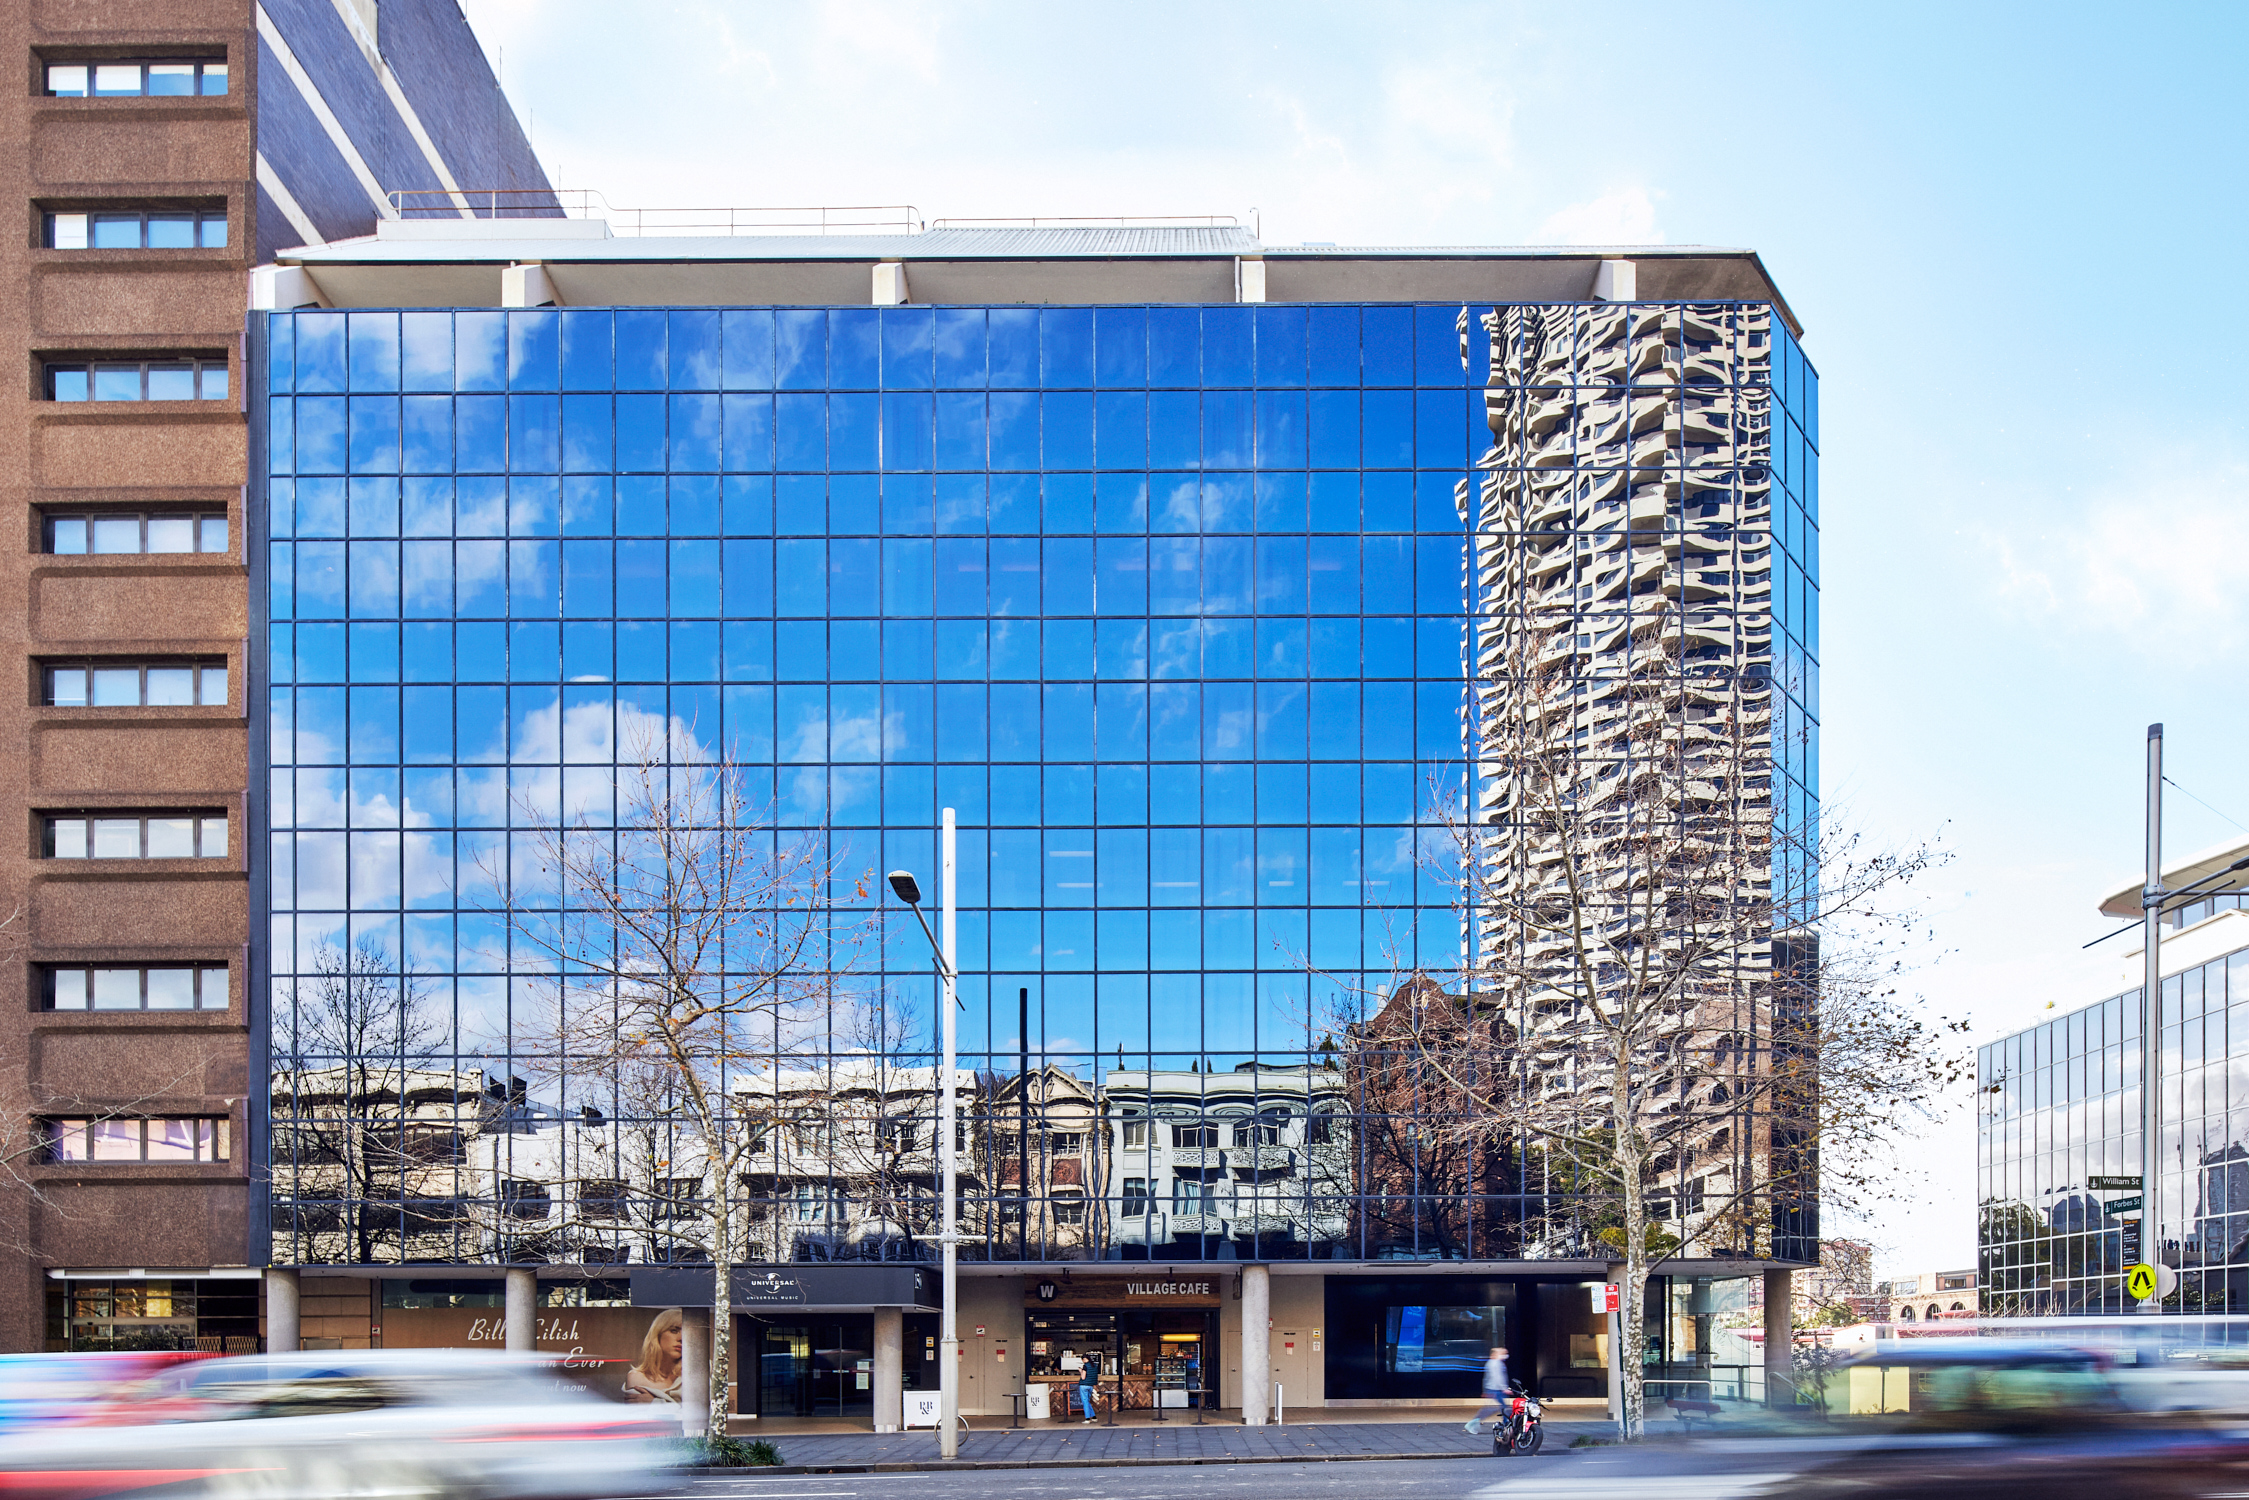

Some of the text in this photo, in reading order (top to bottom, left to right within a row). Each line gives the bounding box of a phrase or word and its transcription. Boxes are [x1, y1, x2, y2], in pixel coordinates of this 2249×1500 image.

[2102, 1177, 2140, 1185] William St
[2113, 1197, 2140, 1209] Forbes St
[1039, 1285, 1055, 1298] W
[1127, 1282, 1210, 1295] VILLAGE CAFE
[467, 1318, 507, 1341] Bill
[564, 1346, 605, 1369] Ever
[562, 1383, 587, 1392] now
